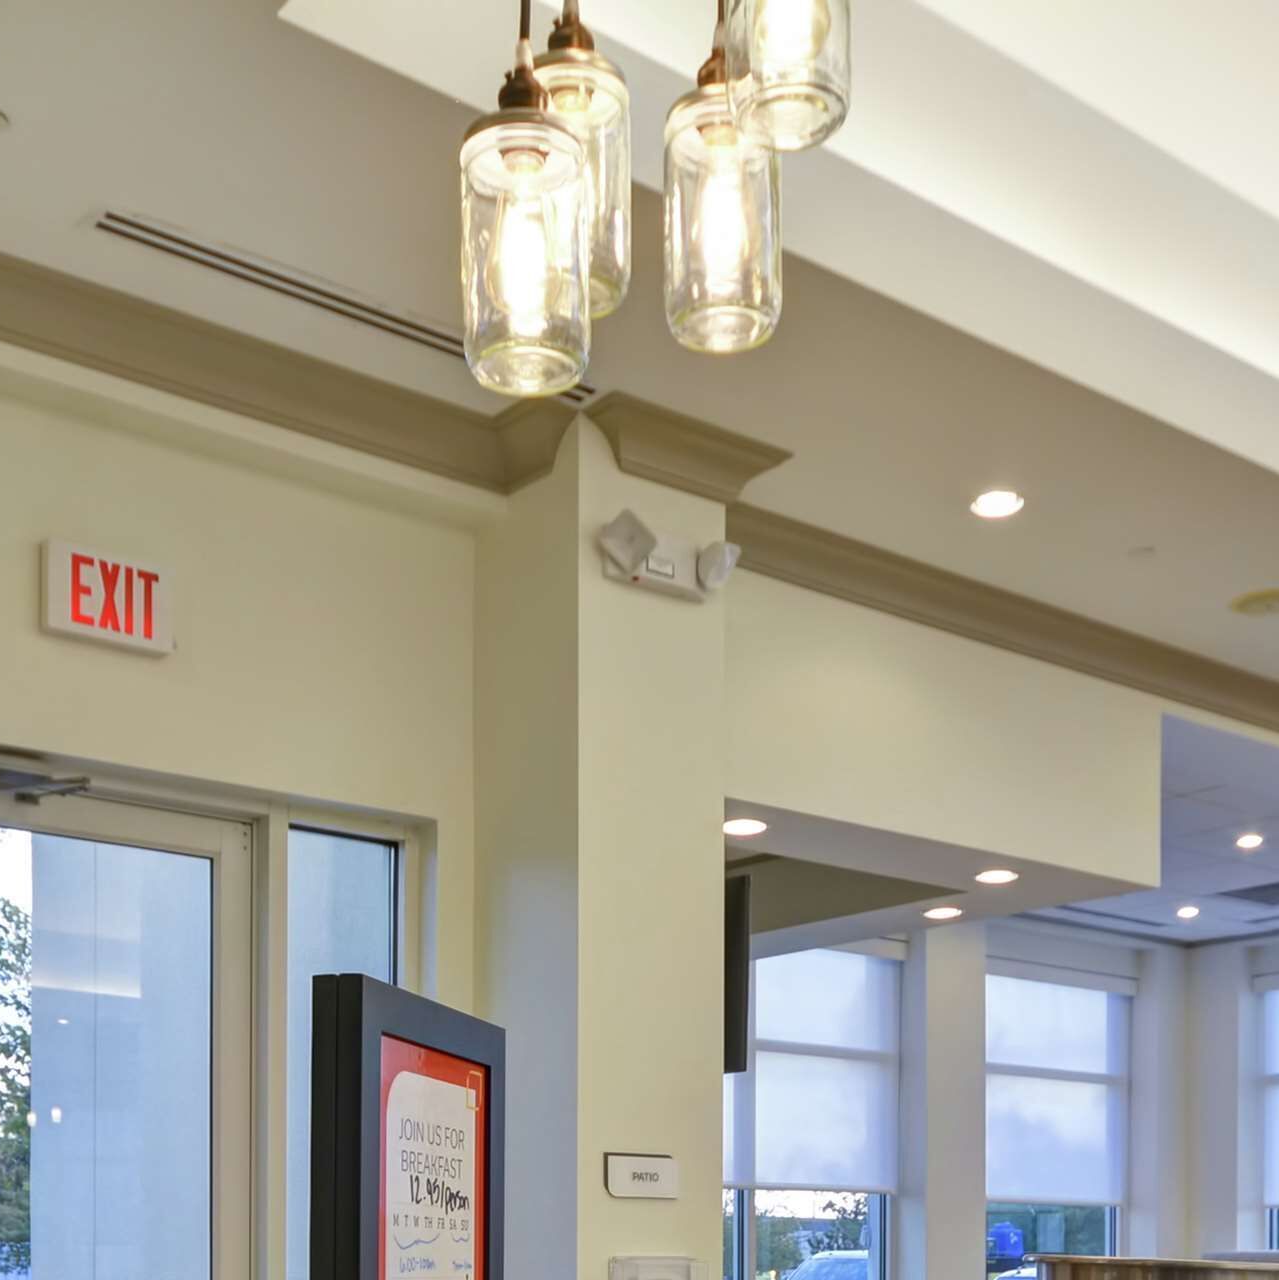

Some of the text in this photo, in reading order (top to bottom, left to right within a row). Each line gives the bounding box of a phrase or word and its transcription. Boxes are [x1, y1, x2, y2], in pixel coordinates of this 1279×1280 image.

[71, 552, 159, 640] EXIT
[399, 1118, 464, 1149] JOIN US FOR
[401, 1150, 463, 1180] BREAKFAST
[632, 1172, 659, 1182] PATIO
[424, 1216, 433, 1229] TH
